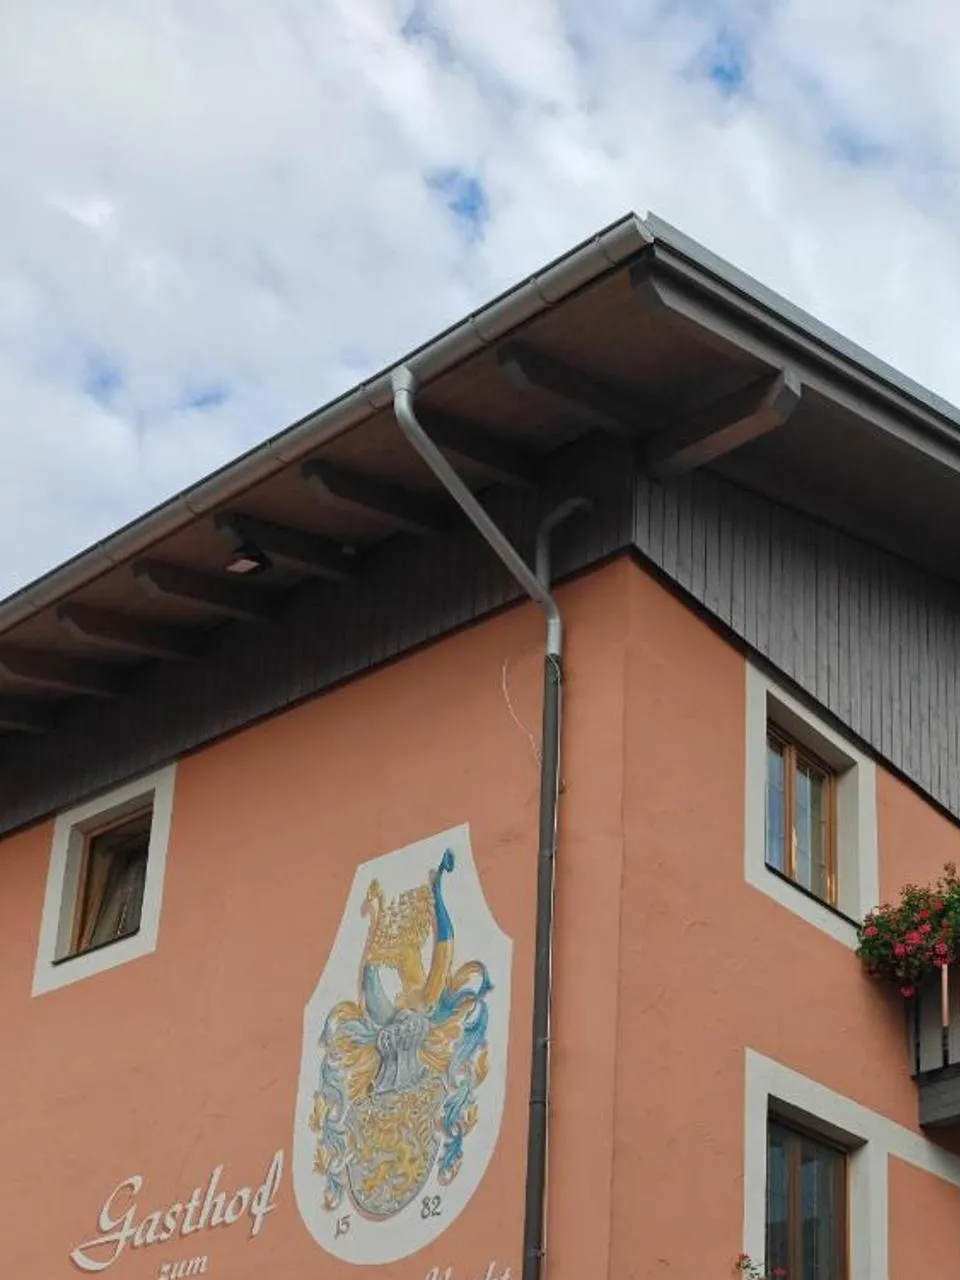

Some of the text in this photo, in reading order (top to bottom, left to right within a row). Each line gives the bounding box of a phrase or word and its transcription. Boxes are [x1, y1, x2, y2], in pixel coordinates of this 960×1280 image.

[70, 1149, 285, 1272] Gasthof
[332, 1195, 442, 1241] 15 82
